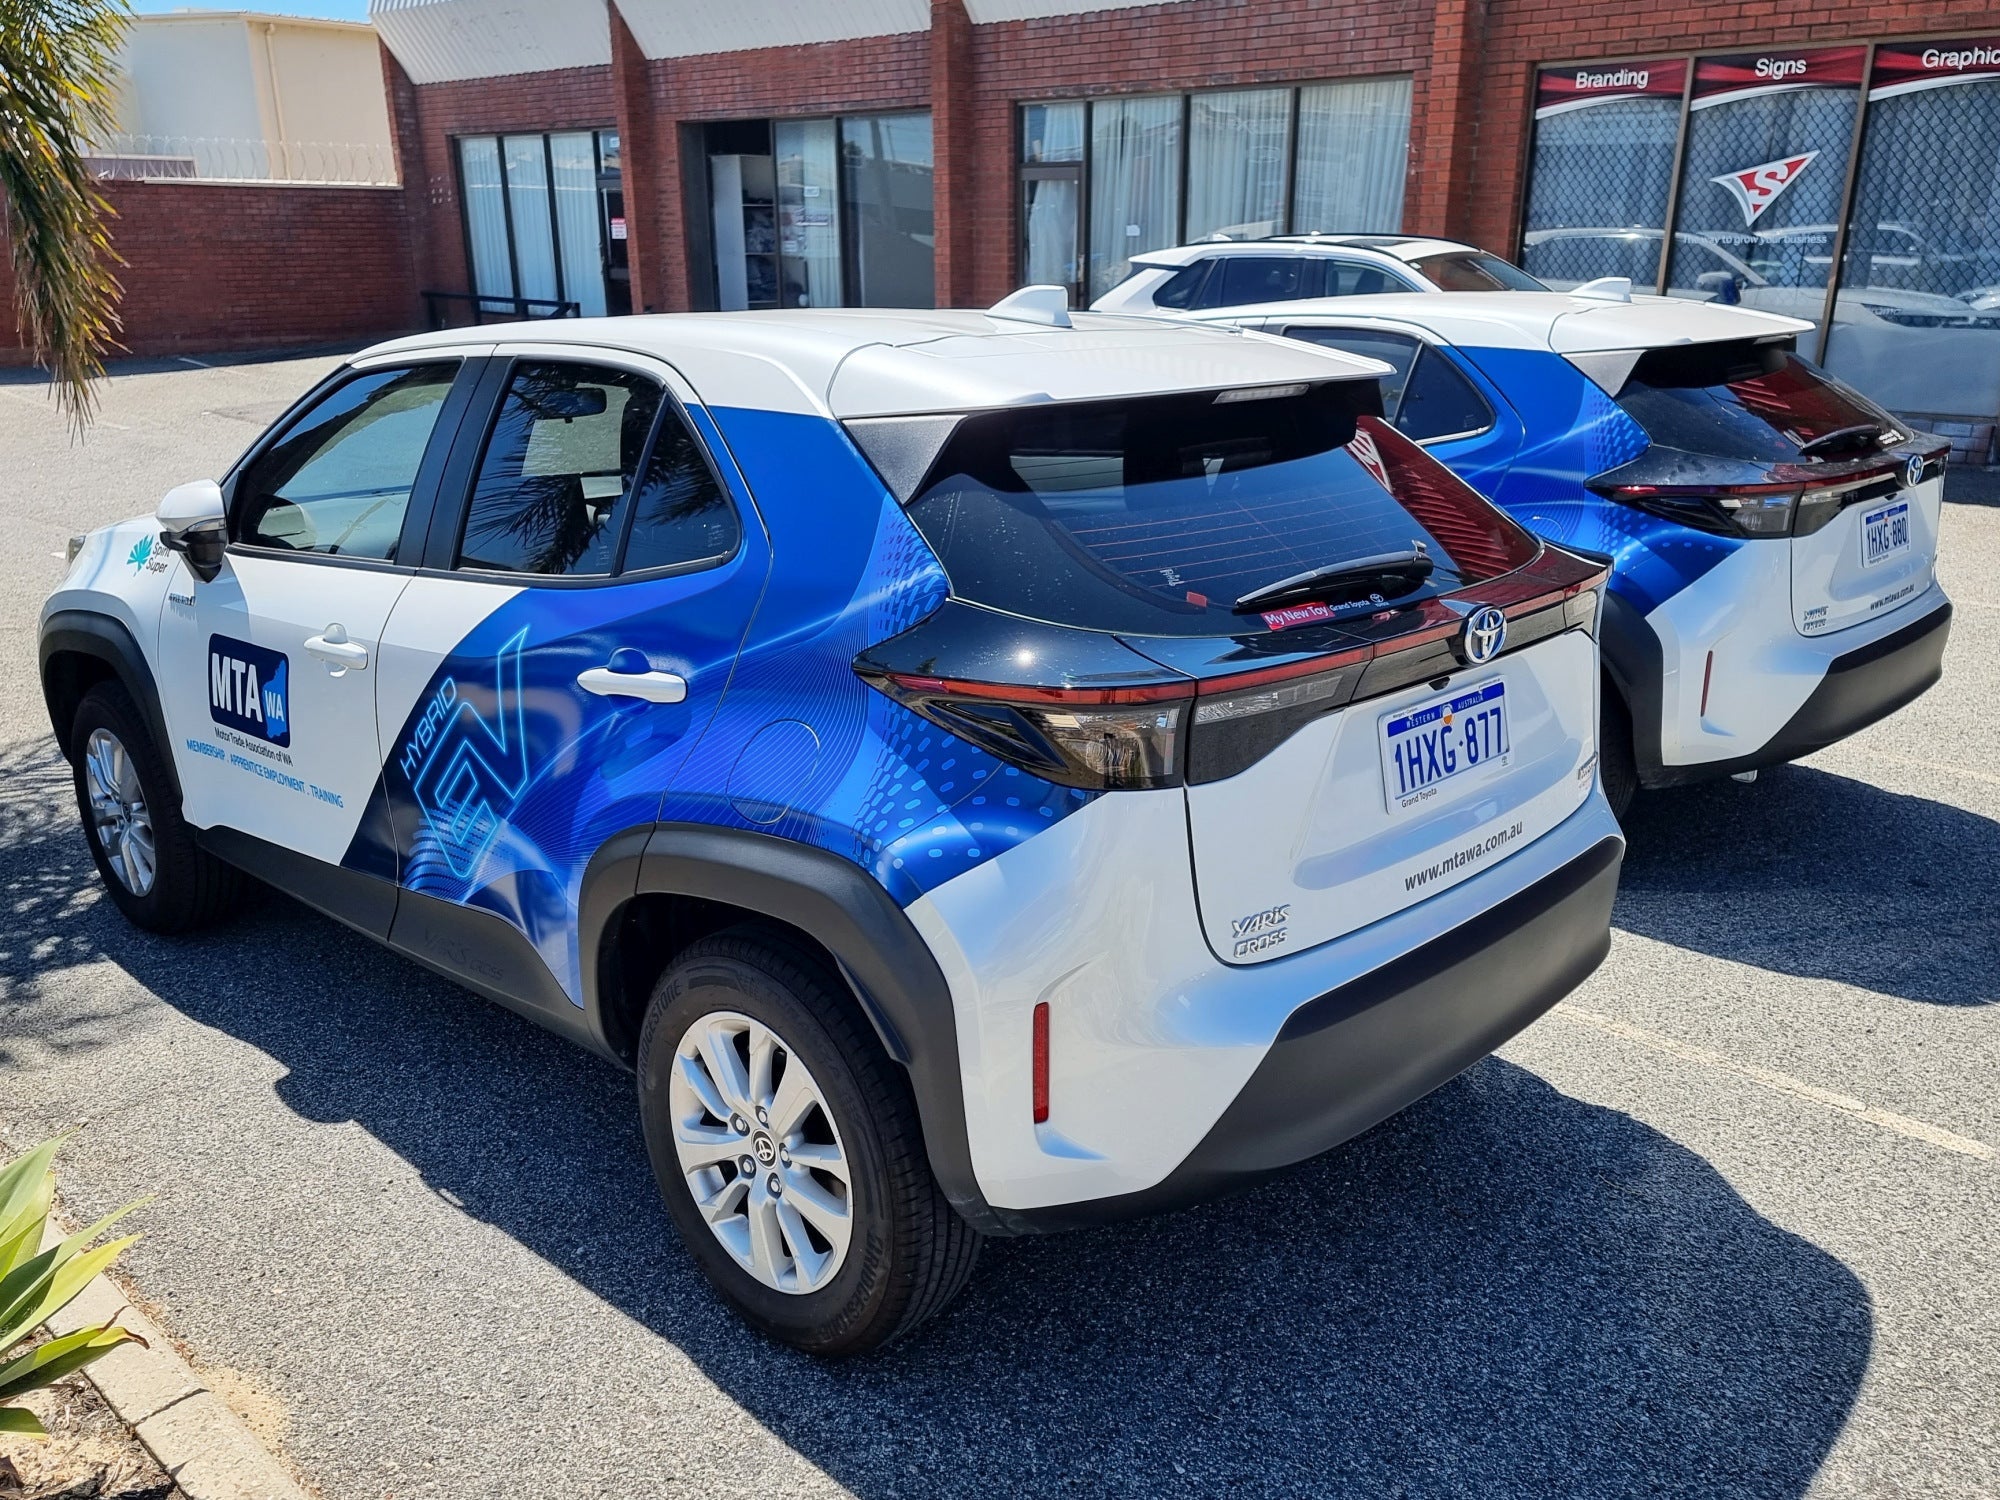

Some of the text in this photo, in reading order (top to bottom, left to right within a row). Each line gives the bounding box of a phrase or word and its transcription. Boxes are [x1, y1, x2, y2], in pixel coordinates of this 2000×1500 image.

[1575, 68, 1649, 90] Branding
[1754, 57, 1807, 80] Signs
[1722, 235, 1732, 245] to
[1733, 236, 1759, 246] grow
[1760, 236, 1782, 246] your
[1783, 234, 1828, 245] business
[146, 557, 168, 575] Super
[1264, 604, 1329, 626] My New Toy
[1329, 599, 1371, 612] Grand Toyota
[212, 652, 285, 723] MTA WA
[1406, 711, 1436, 729] WESTERN
[1458, 692, 1484, 710] AUSTRALIA
[400, 677, 457, 780] HYBRID
[214, 726, 294, 768] Motor Trade Association of WA
[186, 739, 344, 808] MEMBERSHIP APPRENTICE EMPLOYMENT TRAINING
[1401, 787, 1438, 808] Grand Toyota
[1404, 821, 1523, 892] www.mtawa.com.au
[1233, 926, 1289, 959] CROSS
